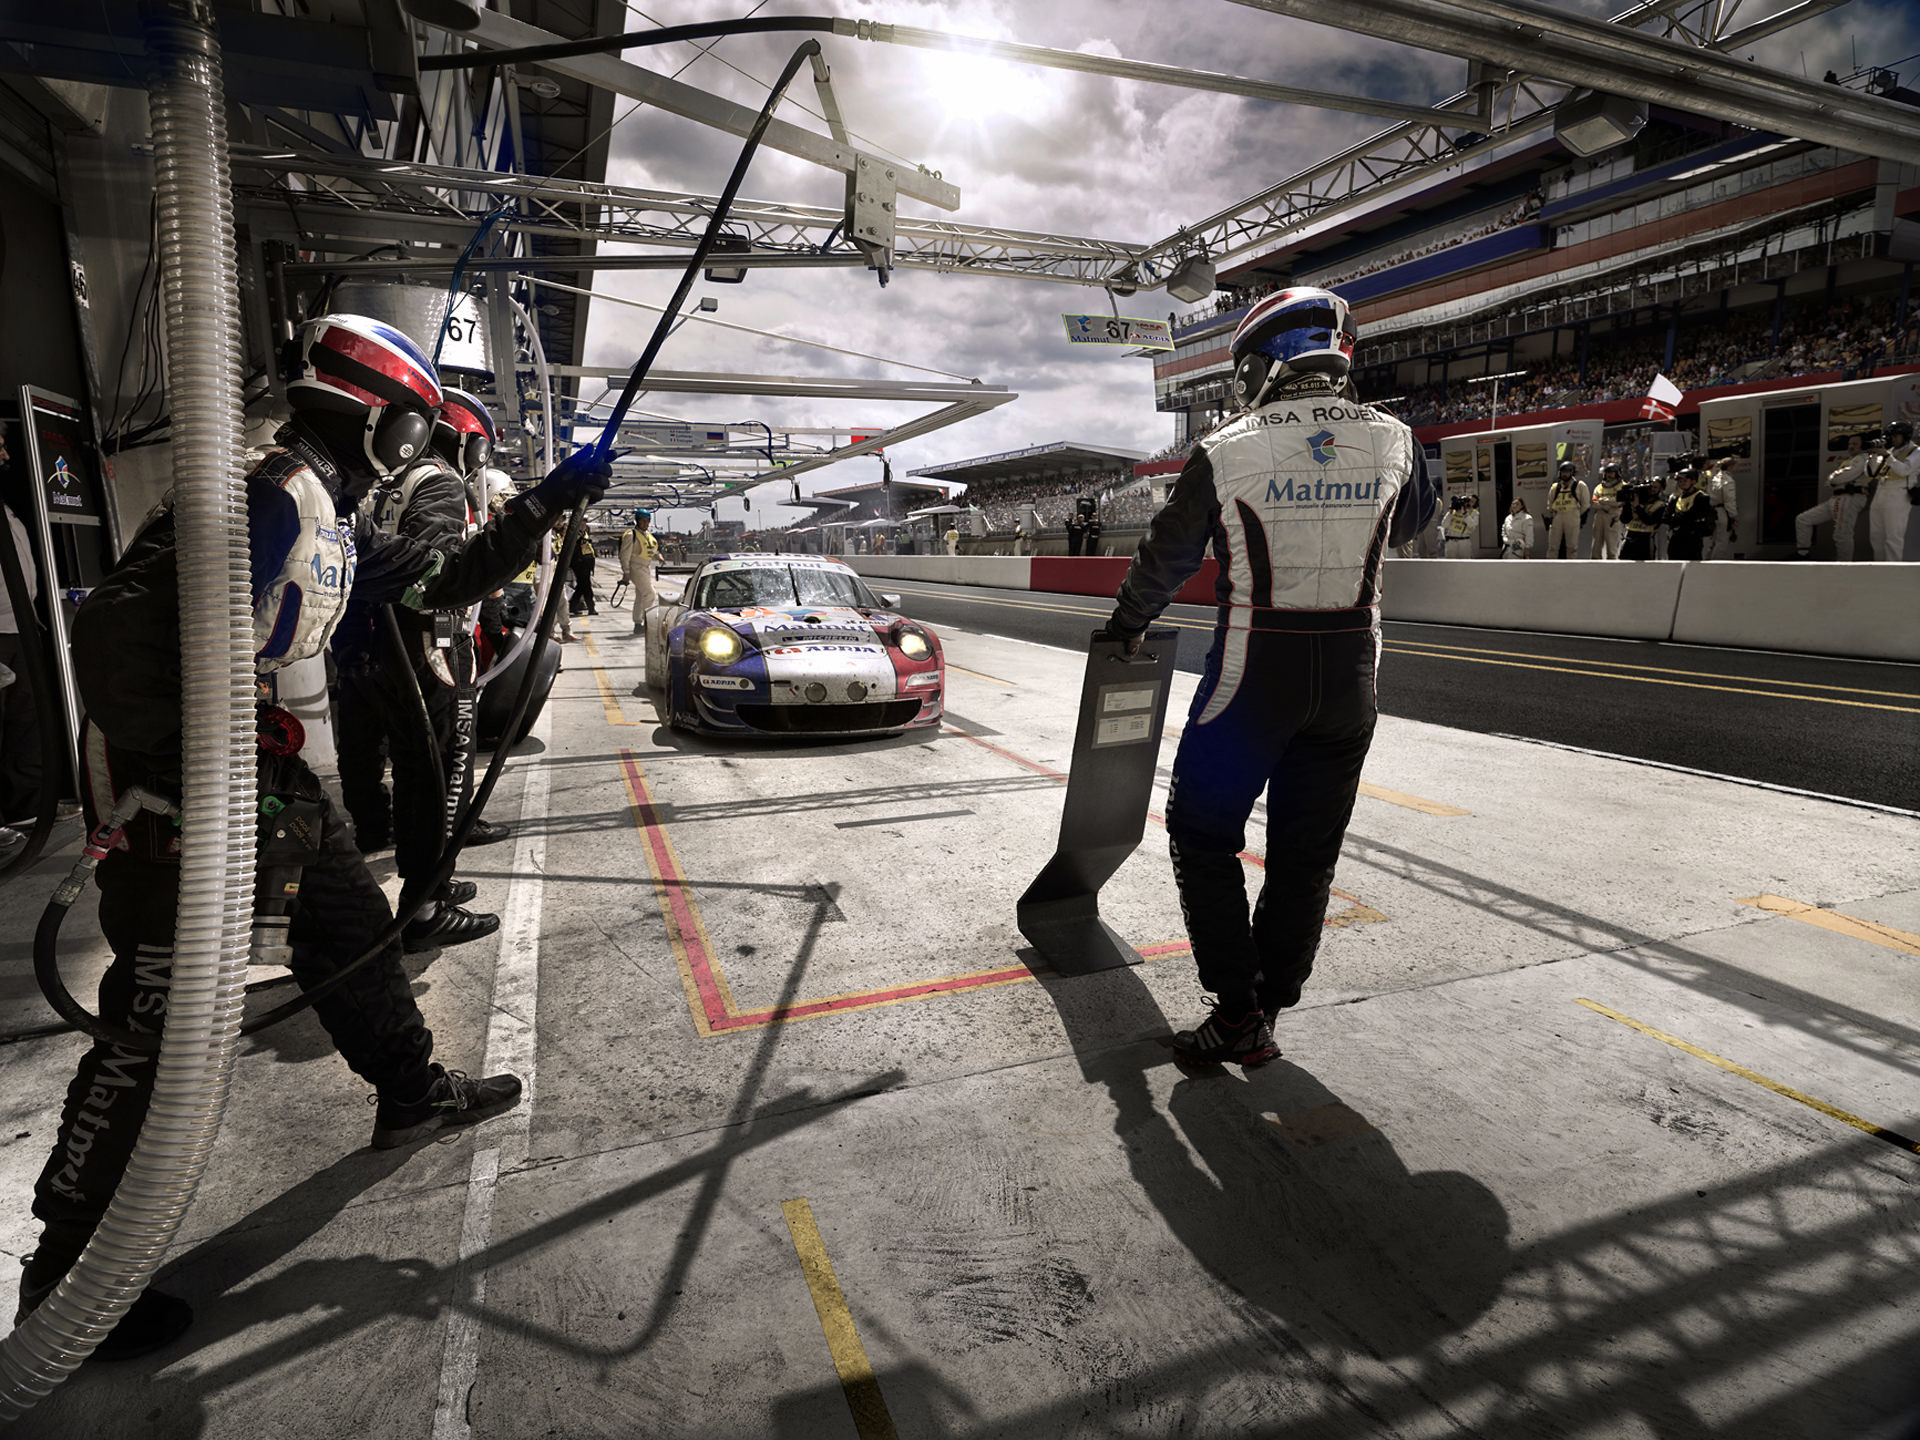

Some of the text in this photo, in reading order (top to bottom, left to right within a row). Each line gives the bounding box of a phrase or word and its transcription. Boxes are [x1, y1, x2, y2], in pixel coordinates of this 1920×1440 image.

[447, 316, 476, 344] 67
[1071, 335, 1110, 343] Matmut
[1106, 320, 1130, 340] 67
[1246, 405, 1384, 431] IMSA ROUEN
[1264, 477, 1382, 502] Matmut
[764, 624, 867, 633] Matmut
[445, 699, 473, 838] IMSA Matmut
